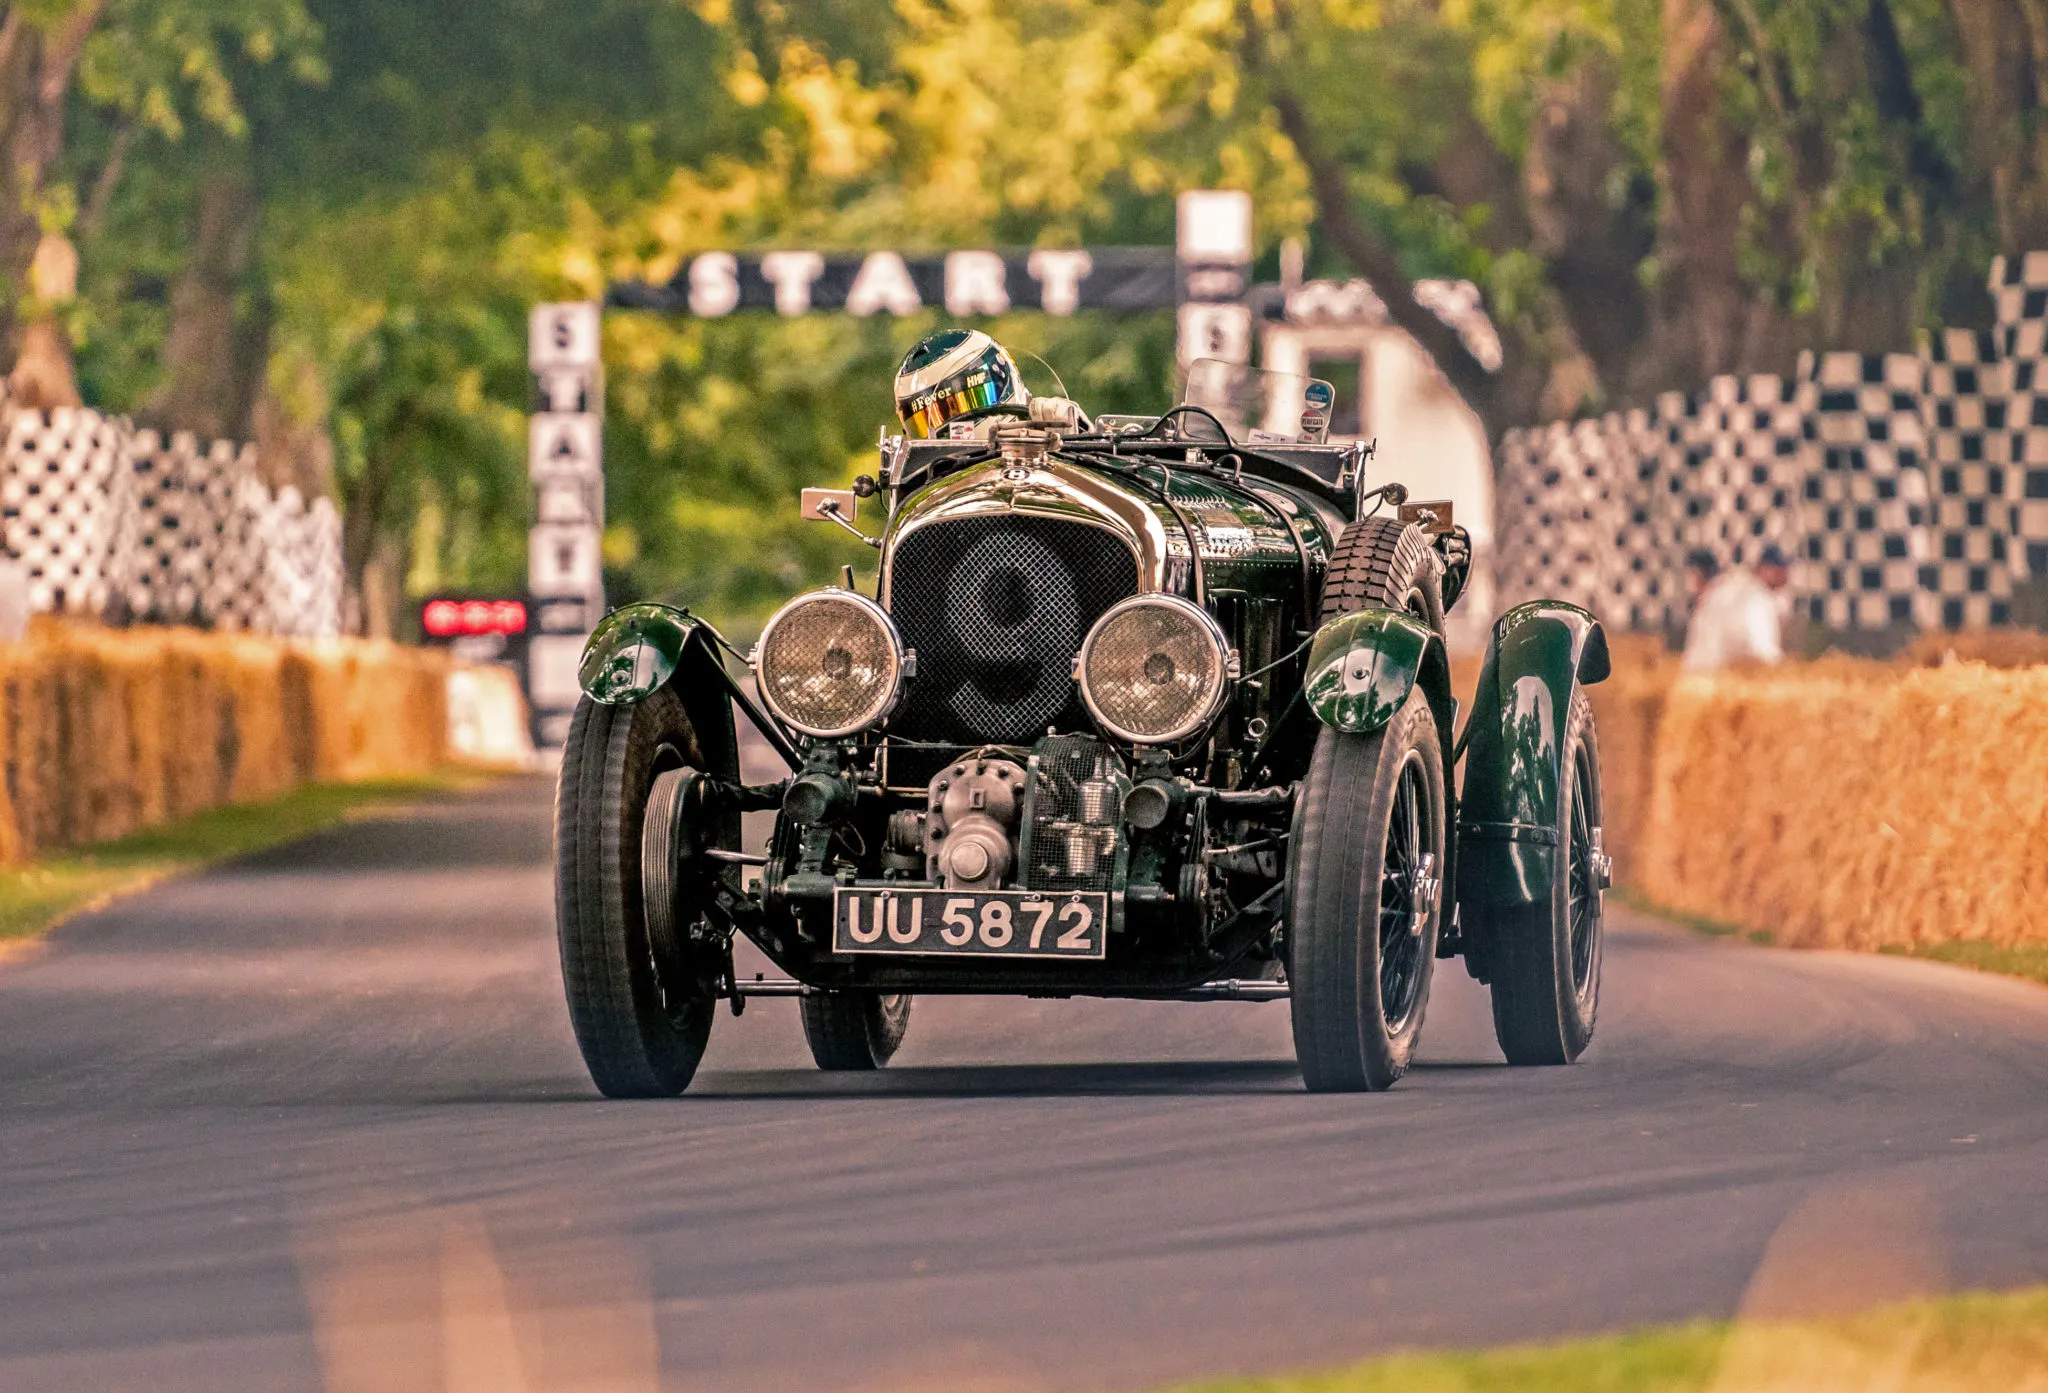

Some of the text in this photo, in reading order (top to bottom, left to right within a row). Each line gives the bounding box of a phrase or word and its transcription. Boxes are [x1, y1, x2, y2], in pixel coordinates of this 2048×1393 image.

[688, 250, 1093, 318] START
[911, 386, 952, 413] #Fever
[948, 531, 1080, 741] 9
[849, 897, 1094, 950] UU 5872
